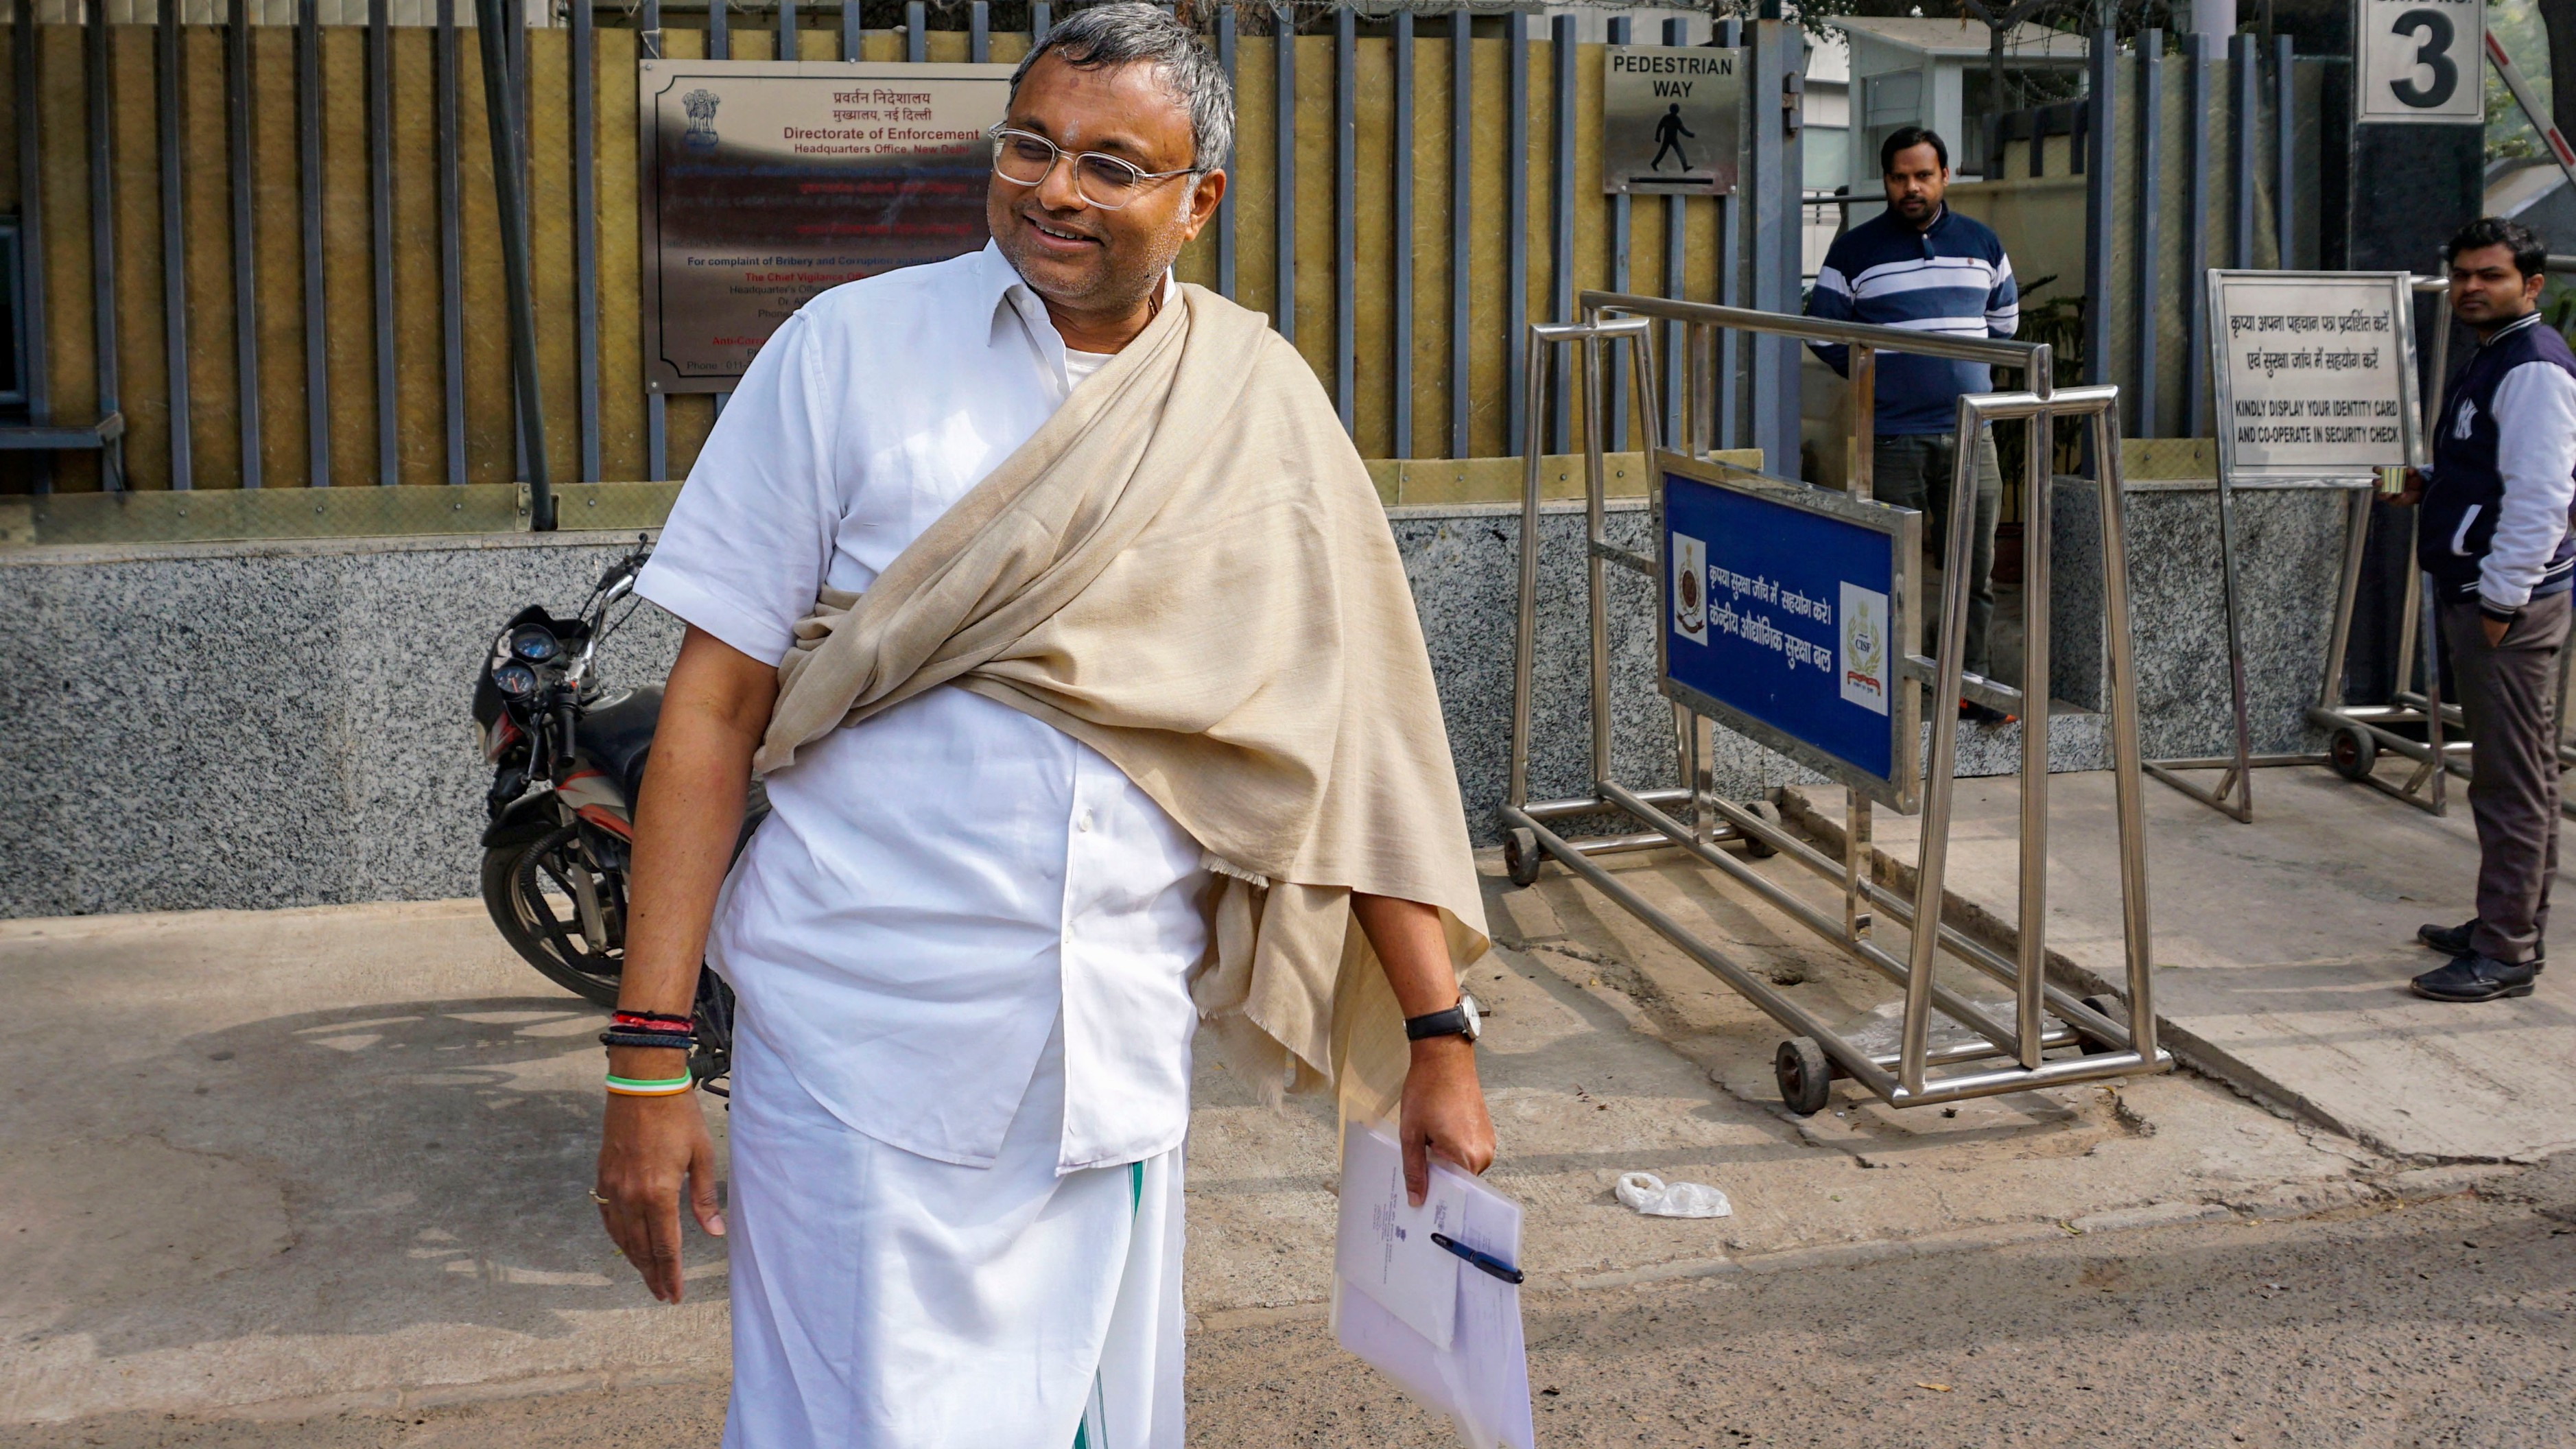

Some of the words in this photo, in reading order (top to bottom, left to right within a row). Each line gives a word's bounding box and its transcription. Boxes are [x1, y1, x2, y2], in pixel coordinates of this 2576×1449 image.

[1614, 55, 1732, 75] PEDESTRIAN
[2389, 8, 2459, 108] 3
[832, 89, 869, 104] प्रवर्तन
[873, 89, 932, 105] निदेशालय
[1653, 80, 1694, 98] WAY
[884, 108, 900, 122] नई
[903, 107, 932, 121] दिल्ली
[783, 126, 864, 139] Directorate
[869, 128, 885, 140] of
[888, 128, 980, 141] Enforcement
[794, 143, 871, 155] Headquarters
[914, 145, 937, 154] New
[941, 145, 970, 154] Delhi
[687, 257, 705, 266] For
[708, 257, 759, 267] complaint
[762, 257, 772, 266] of
[776, 257, 813, 267] Bribery
[838, 257, 892, 267] Corruption
[745, 272, 764, 282] The
[768, 272, 795, 282] Chief
[797, 272, 844, 283] Vigilance
[2258, 316, 2284, 332] अपना
[2287, 316, 2319, 333] पहचान
[2321, 316, 2336, 332] पत्र
[2338, 309, 2372, 335] प्रदर्शित
[2373, 309, 2390, 332] करें
[712, 336, 768, 345] Anti-Corru
[687, 361, 718, 370] Phone
[2247, 346, 2262, 370] एवं
[2263, 353, 2289, 378] सुरक्षा
[2314, 346, 2324, 369] में
[2325, 346, 2361, 370] सहयोग
[2362, 346, 2379, 369] करें
[2235, 400, 2267, 417] KINDLY
[2269, 400, 2304, 417] DISPLAY
[2307, 400, 2330, 417] YOUR
[2333, 400, 2373, 417] IDENTITY
[2375, 400, 2398, 417] CARD
[2238, 426, 2256, 443] AND
[2258, 426, 2311, 443] CO-OPERATE
[2314, 426, 2323, 443] IN
[2326, 426, 2367, 443] SECURITY
[2370, 426, 2400, 443] CHECK
[1709, 565, 1730, 589] कृपया
[1731, 572, 1751, 600] सुरक्षा
[1770, 580, 1779, 605] में
[1781, 589, 1812, 617] सहयोग
[1709, 598, 1739, 635] केन्द्रीय
[1740, 609, 1783, 651] औद्योगिक
[1784, 634, 1812, 670] सुरक्षा
[1813, 644, 1832, 673] बल
[1855, 639, 1871, 652] CISF
